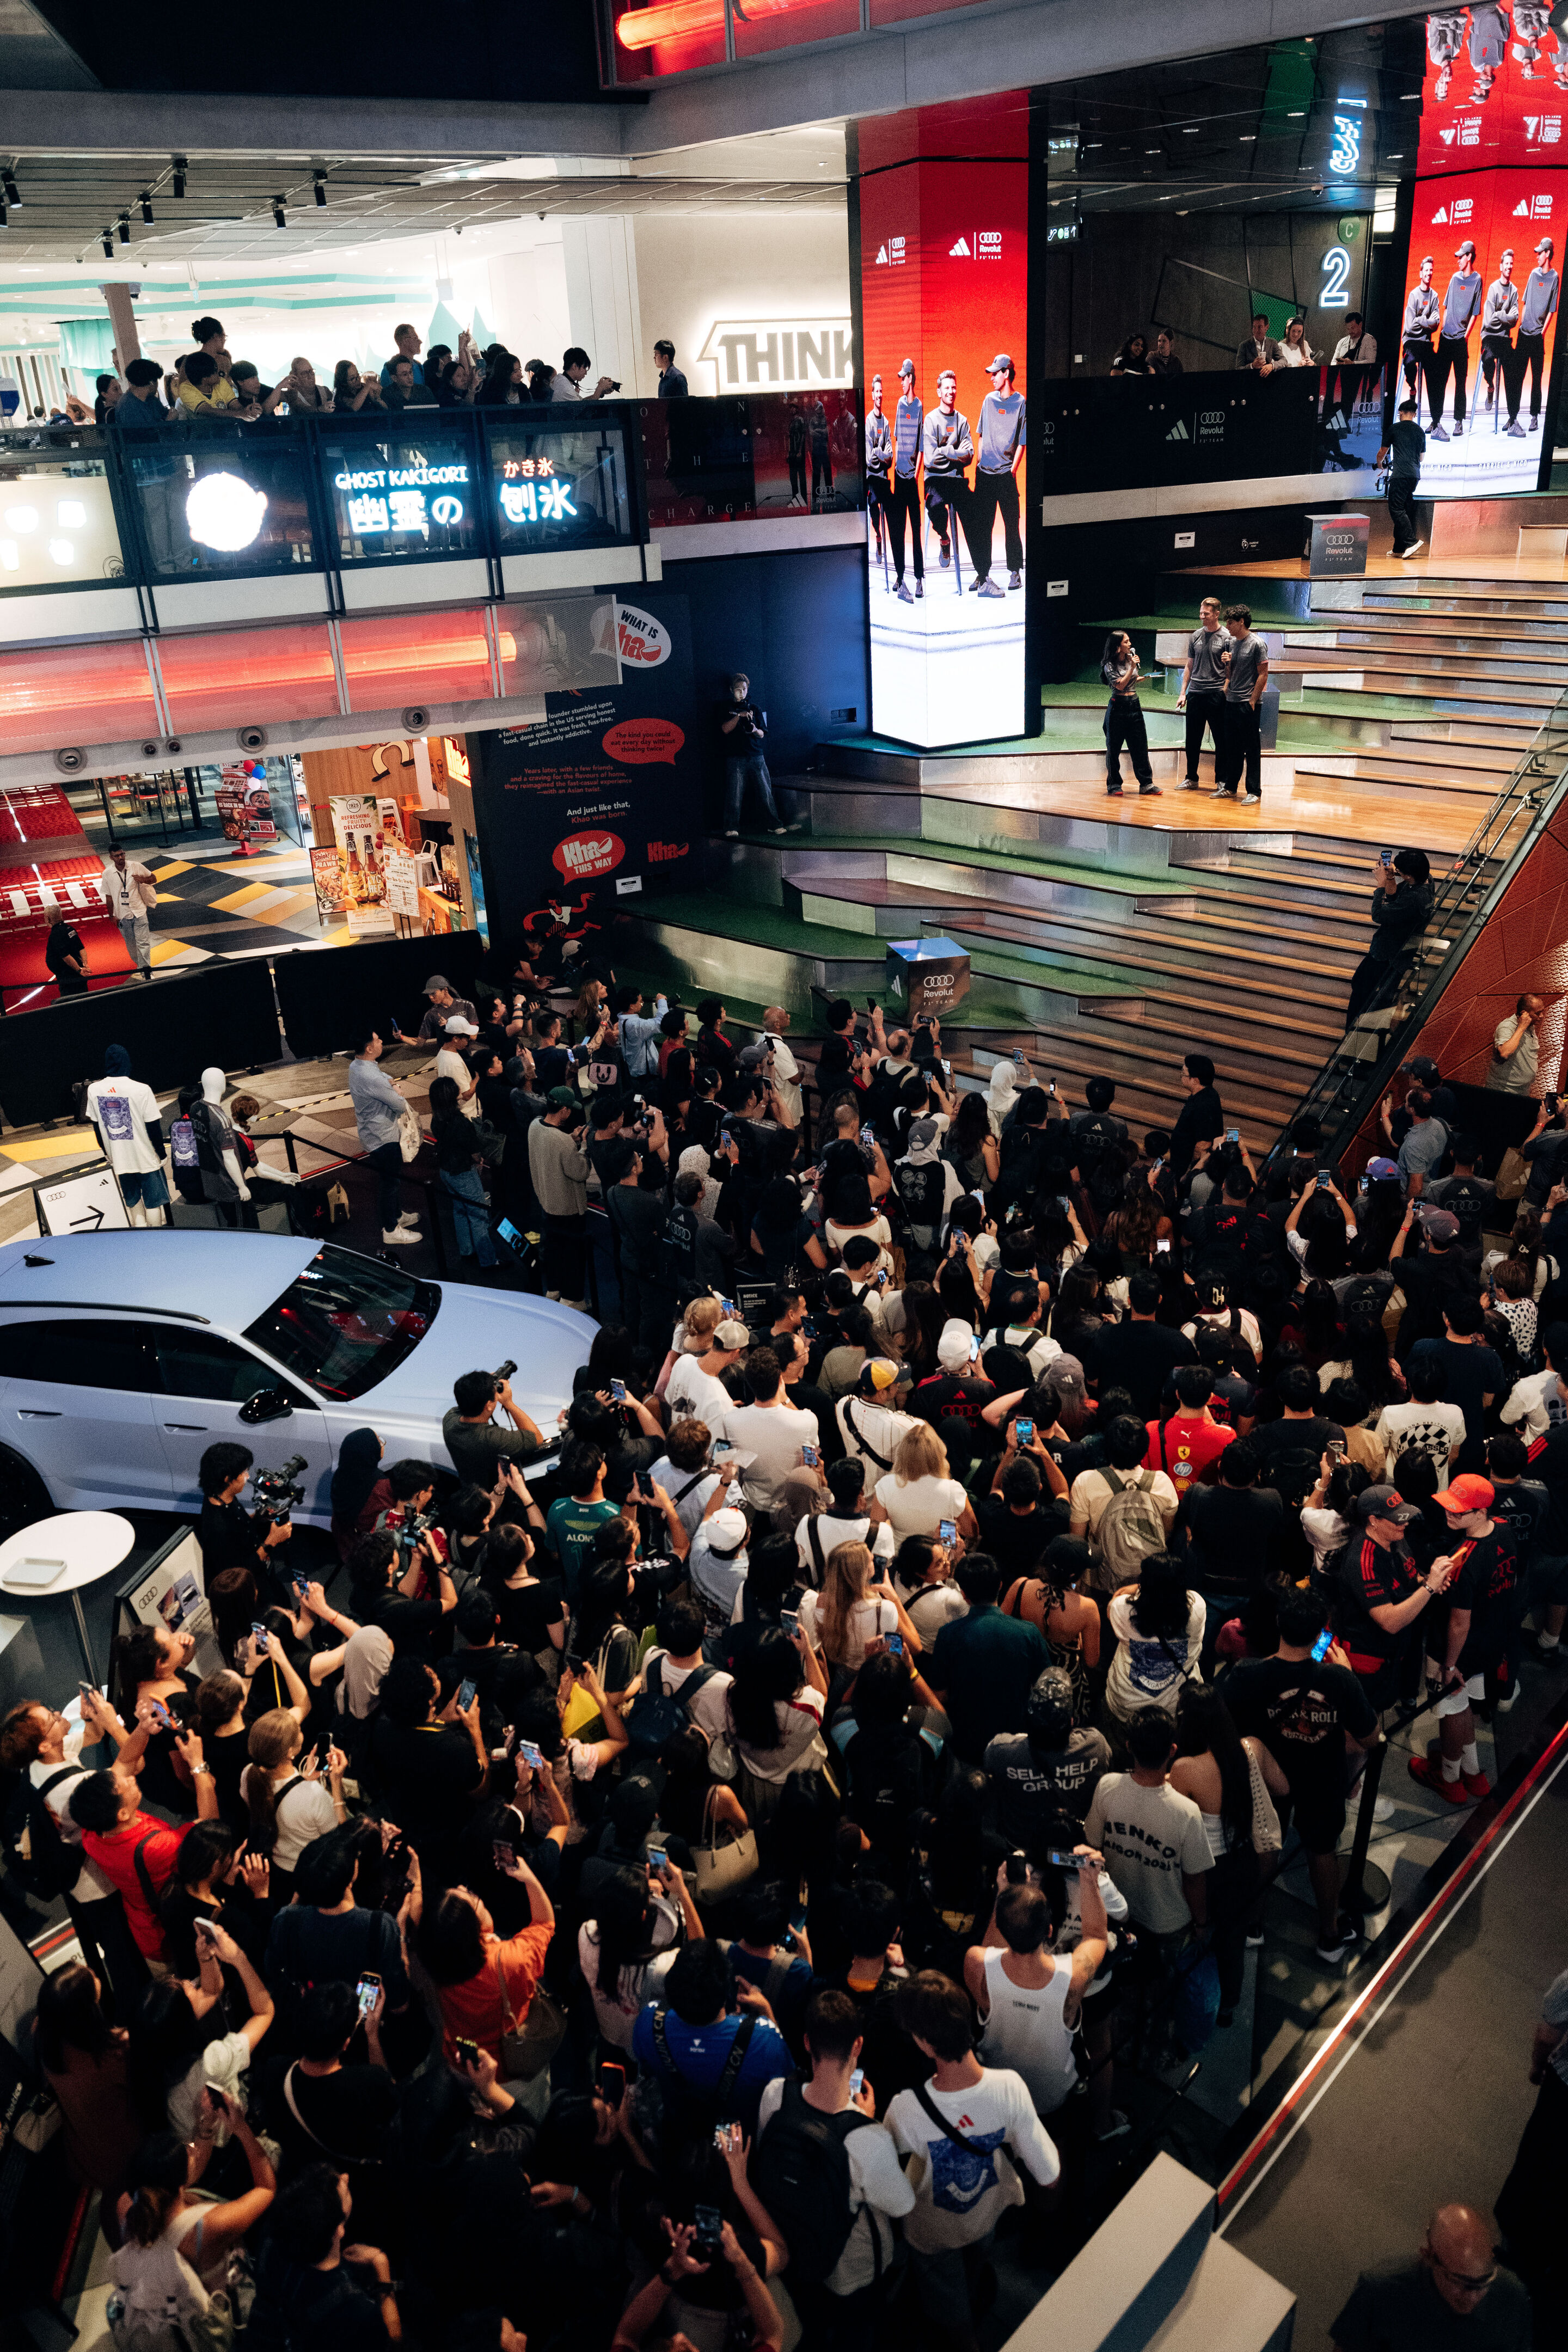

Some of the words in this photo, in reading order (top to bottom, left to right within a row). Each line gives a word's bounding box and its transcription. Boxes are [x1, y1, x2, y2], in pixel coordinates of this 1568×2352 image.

[1345, 223, 1353, 237] C
[892, 249, 905, 258] Revolut
[979, 244, 1001, 253] Revolut
[1320, 246, 1351, 308] 2
[718, 329, 852, 383] THINK
[1200, 426, 1224, 435] Revolut
[503, 457, 554, 478] かき氷
[1478, 462, 1503, 470] GABRIEL
[335, 470, 387, 489] GHOST
[389, 465, 469, 486] KAKIGORI
[1326, 547, 1353, 555] Revolut
[621, 609, 648, 632] WHAT
[647, 626, 659, 639] IS
[548, 710, 570, 719] founder
[572, 703, 597, 714] stumbled
[598, 701, 612, 709] upon
[503, 727, 532, 737] fast-casual
[575, 712, 596, 721] serving
[597, 708, 616, 716] honest
[535, 730, 552, 739] quick.
[588, 717, 614, 726] fuss-free,
[540, 735, 564, 744] instantly
[565, 730, 592, 739] addictive.
[520, 781, 554, 789] reimagined
[529, 774, 551, 782] craving
[566, 807, 582, 816] And
[583, 805, 597, 815] just
[599, 803, 611, 812] like
[613, 801, 631, 810] that,
[571, 816, 590, 824] Khao
[608, 810, 627, 819] born.
[314, 853, 330, 861] Shiok!
[315, 860, 337, 868] PRAWN
[573, 862, 593, 874] THIS
[594, 856, 612, 869] WAY
[923, 988, 954, 998] Revolut
[1398, 1513, 1410, 1521] 27
[566, 1534, 596, 1544] ALONS
[1310, 1710, 1338, 1724] ROLL
[1055, 1757, 1098, 1777] HELP
